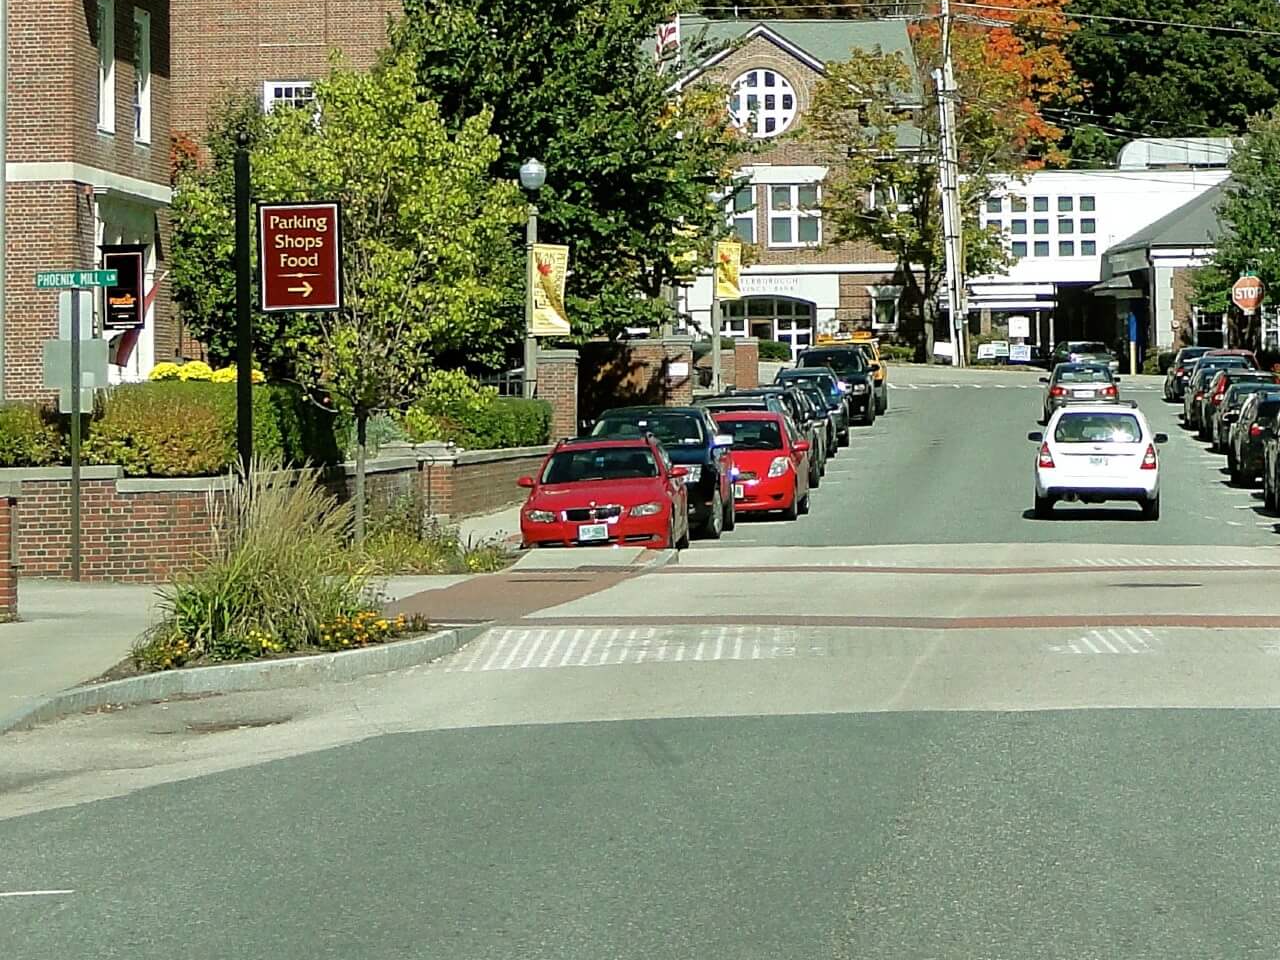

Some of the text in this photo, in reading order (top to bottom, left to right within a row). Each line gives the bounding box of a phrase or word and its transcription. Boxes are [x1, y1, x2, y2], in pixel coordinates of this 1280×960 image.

[270, 215, 328, 232] Parking
[274, 234, 324, 252] Shops
[280, 253, 319, 268] Food
[37, 273, 76, 287] PHOENIX
[80, 271, 101, 285] MILL
[1235, 287, 1263, 299] STOP
